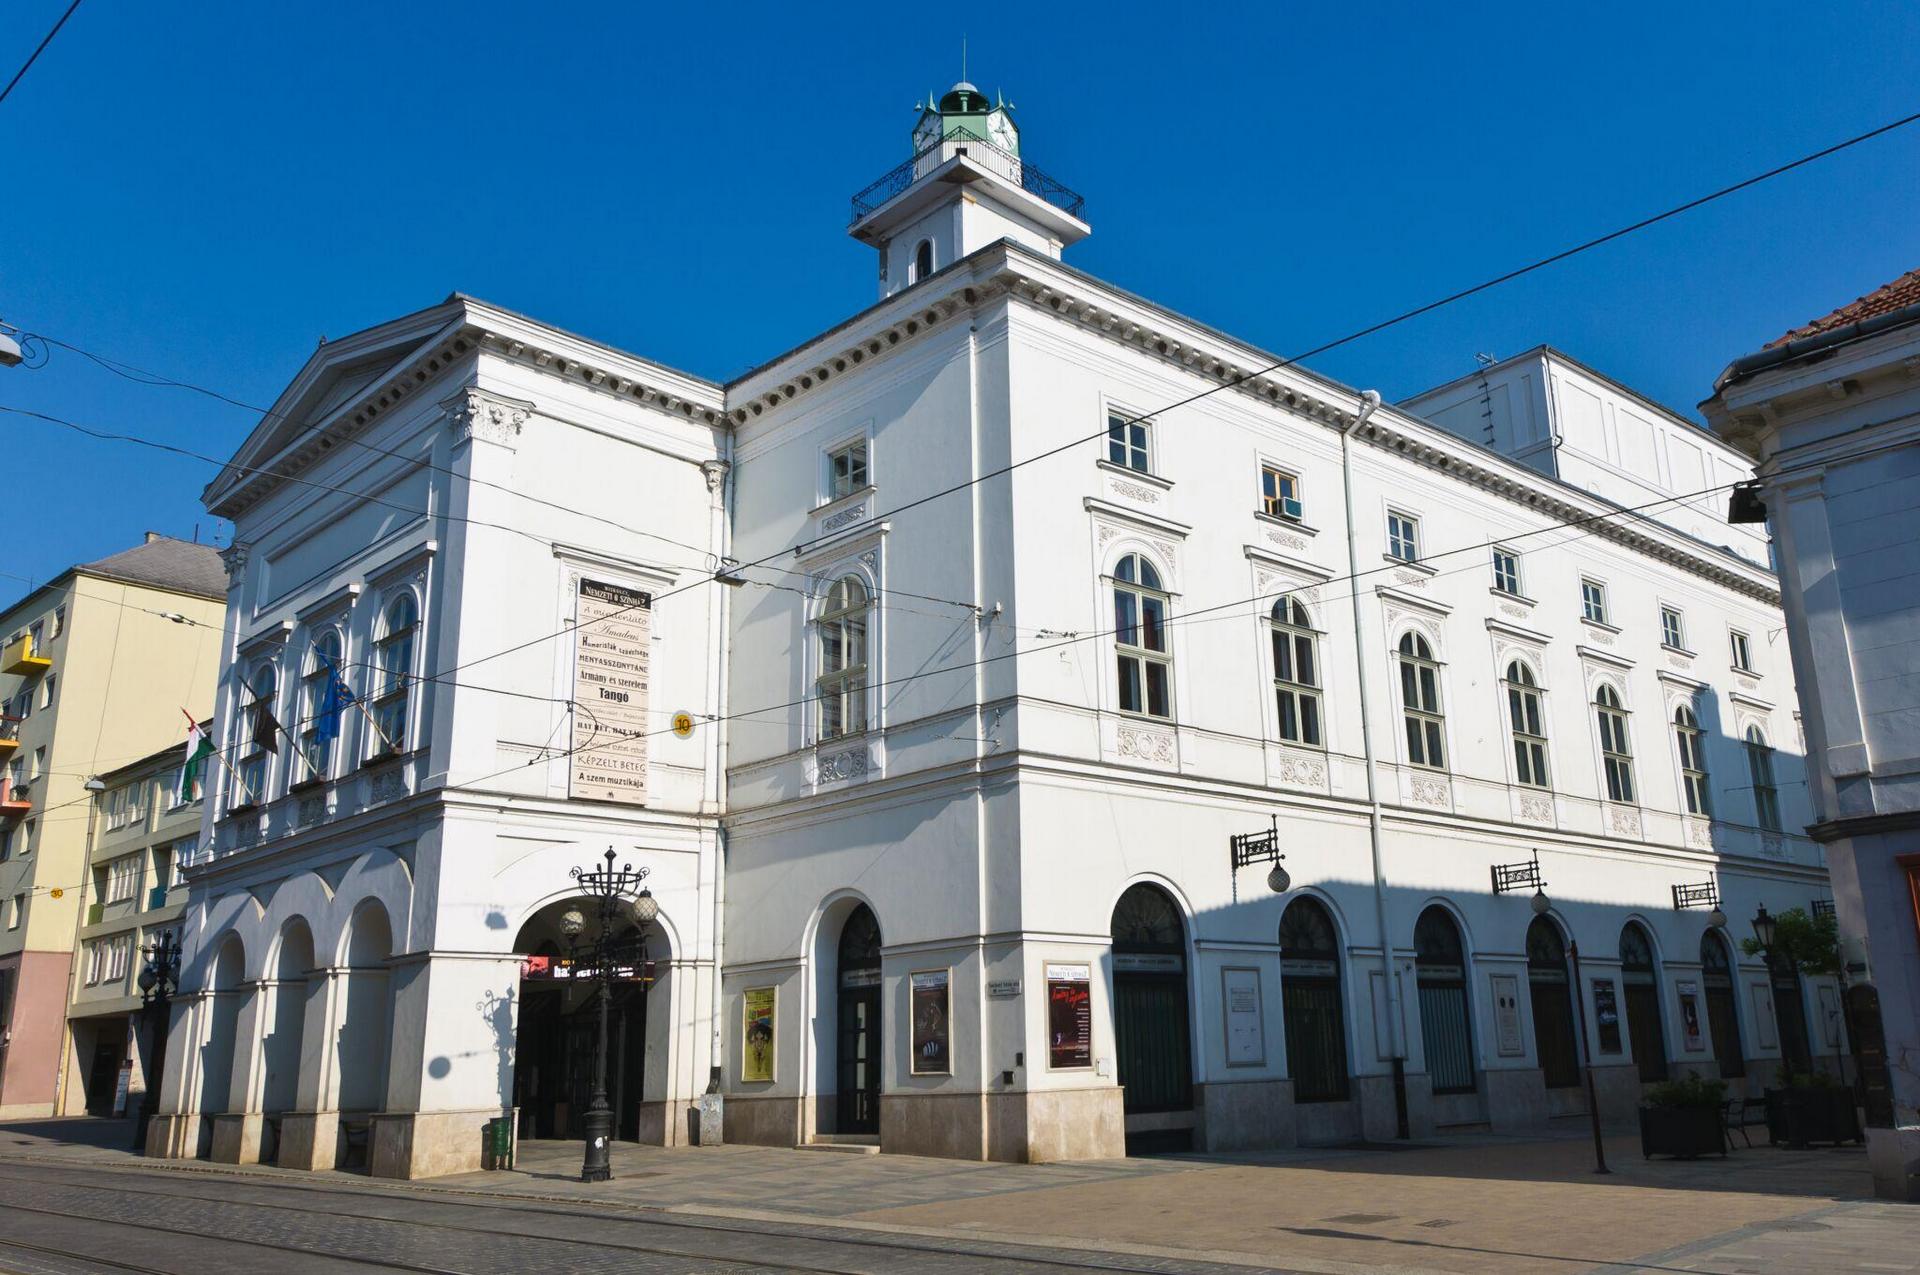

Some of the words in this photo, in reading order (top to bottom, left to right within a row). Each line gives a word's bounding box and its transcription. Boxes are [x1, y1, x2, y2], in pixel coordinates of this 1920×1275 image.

[585, 586, 613, 600] NEMZETI
[598, 623, 639, 641] Amadeus
[618, 677, 648, 690] szerelem
[599, 687, 629, 703] Tangó
[677, 718, 690, 731] 10
[577, 755, 618, 769] KÉPZELT
[620, 760, 646, 773] BETEG
[578, 772, 585, 780] A
[586, 774, 606, 783] szem
